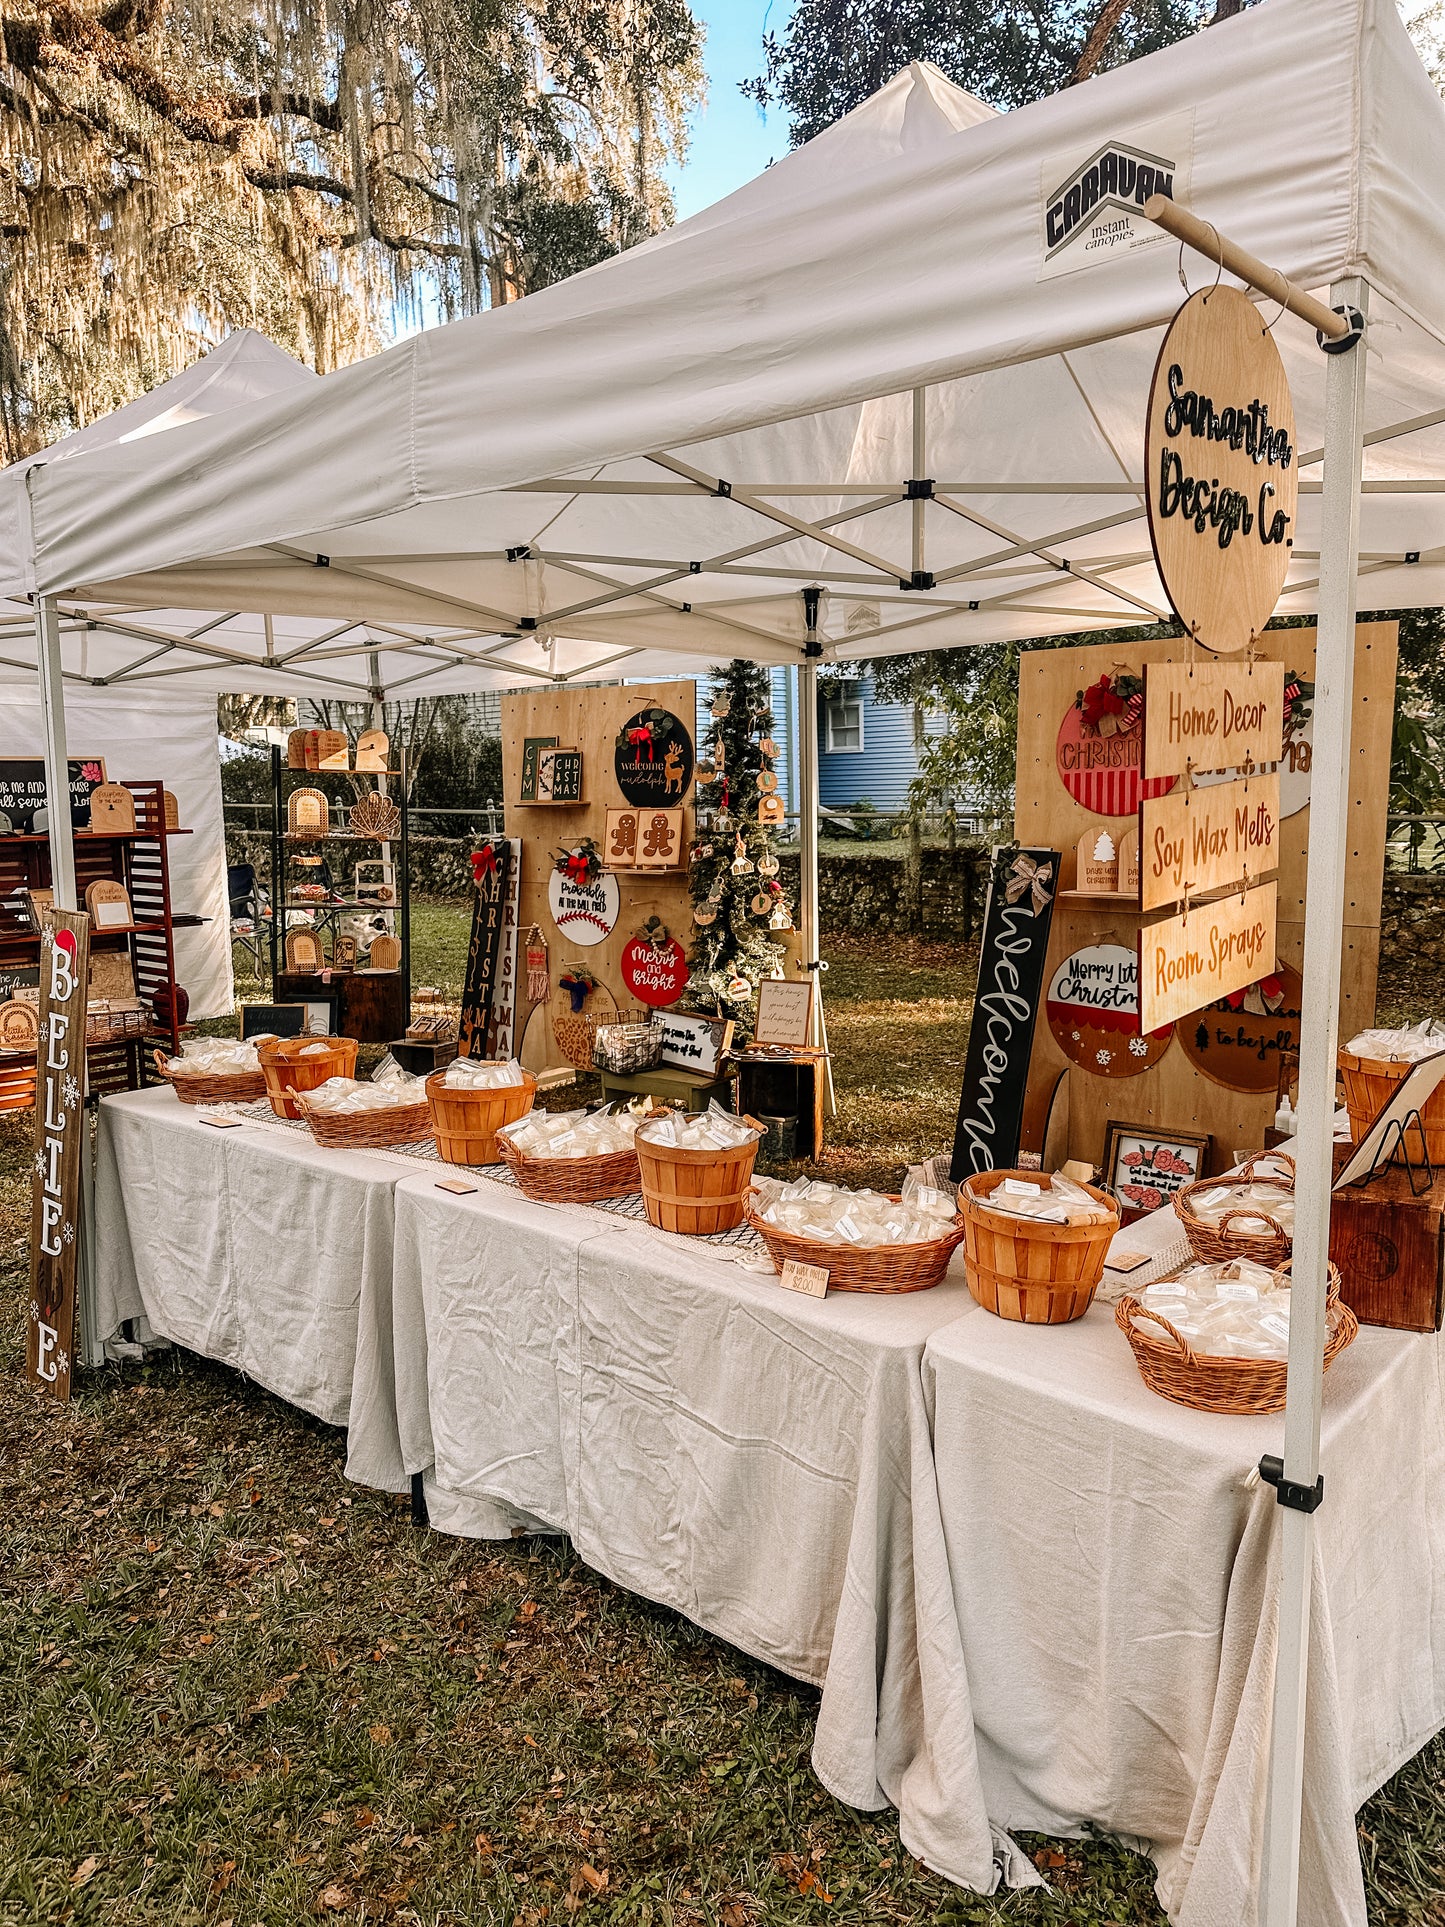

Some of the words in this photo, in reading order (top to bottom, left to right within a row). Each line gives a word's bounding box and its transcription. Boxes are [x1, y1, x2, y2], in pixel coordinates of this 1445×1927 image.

[1046, 152, 1174, 248] CARAVAN
[1092, 217, 1130, 239] instant
[1085, 229, 1135, 251] canopies
[1165, 364, 1293, 469] Samantha
[1160, 447, 1254, 549] Design
[1259, 481, 1293, 547] Co.
[1168, 691, 1218, 743] Home
[1223, 689, 1267, 738] Decor
[621, 760, 664, 771] welcome
[27, 781, 46, 794] AND
[69, 781, 90, 793] OUSE
[620, 771, 666, 789] rudolph
[1153, 826, 1185, 887] Soy
[1192, 815, 1229, 866] Wax
[1235, 801, 1275, 853] Melts
[561, 881, 607, 902] Probably
[1086, 876, 1118, 884] CHRISTMA
[577, 898, 590, 911] BALL
[472, 857, 504, 1056] CHRISTMA
[499, 855, 518, 1061] CHRISTMA
[632, 946, 678, 968] Merry
[1155, 947, 1204, 996] Room
[1209, 922, 1267, 981] Sprays
[632, 969, 676, 990] Bright
[1069, 958, 1114, 983] Merry
[1057, 977, 1138, 1008] Christm
[962, 907, 1034, 1172] welcome
[1216, 1027, 1235, 1045] to
[1236, 1025, 1258, 1047] be
